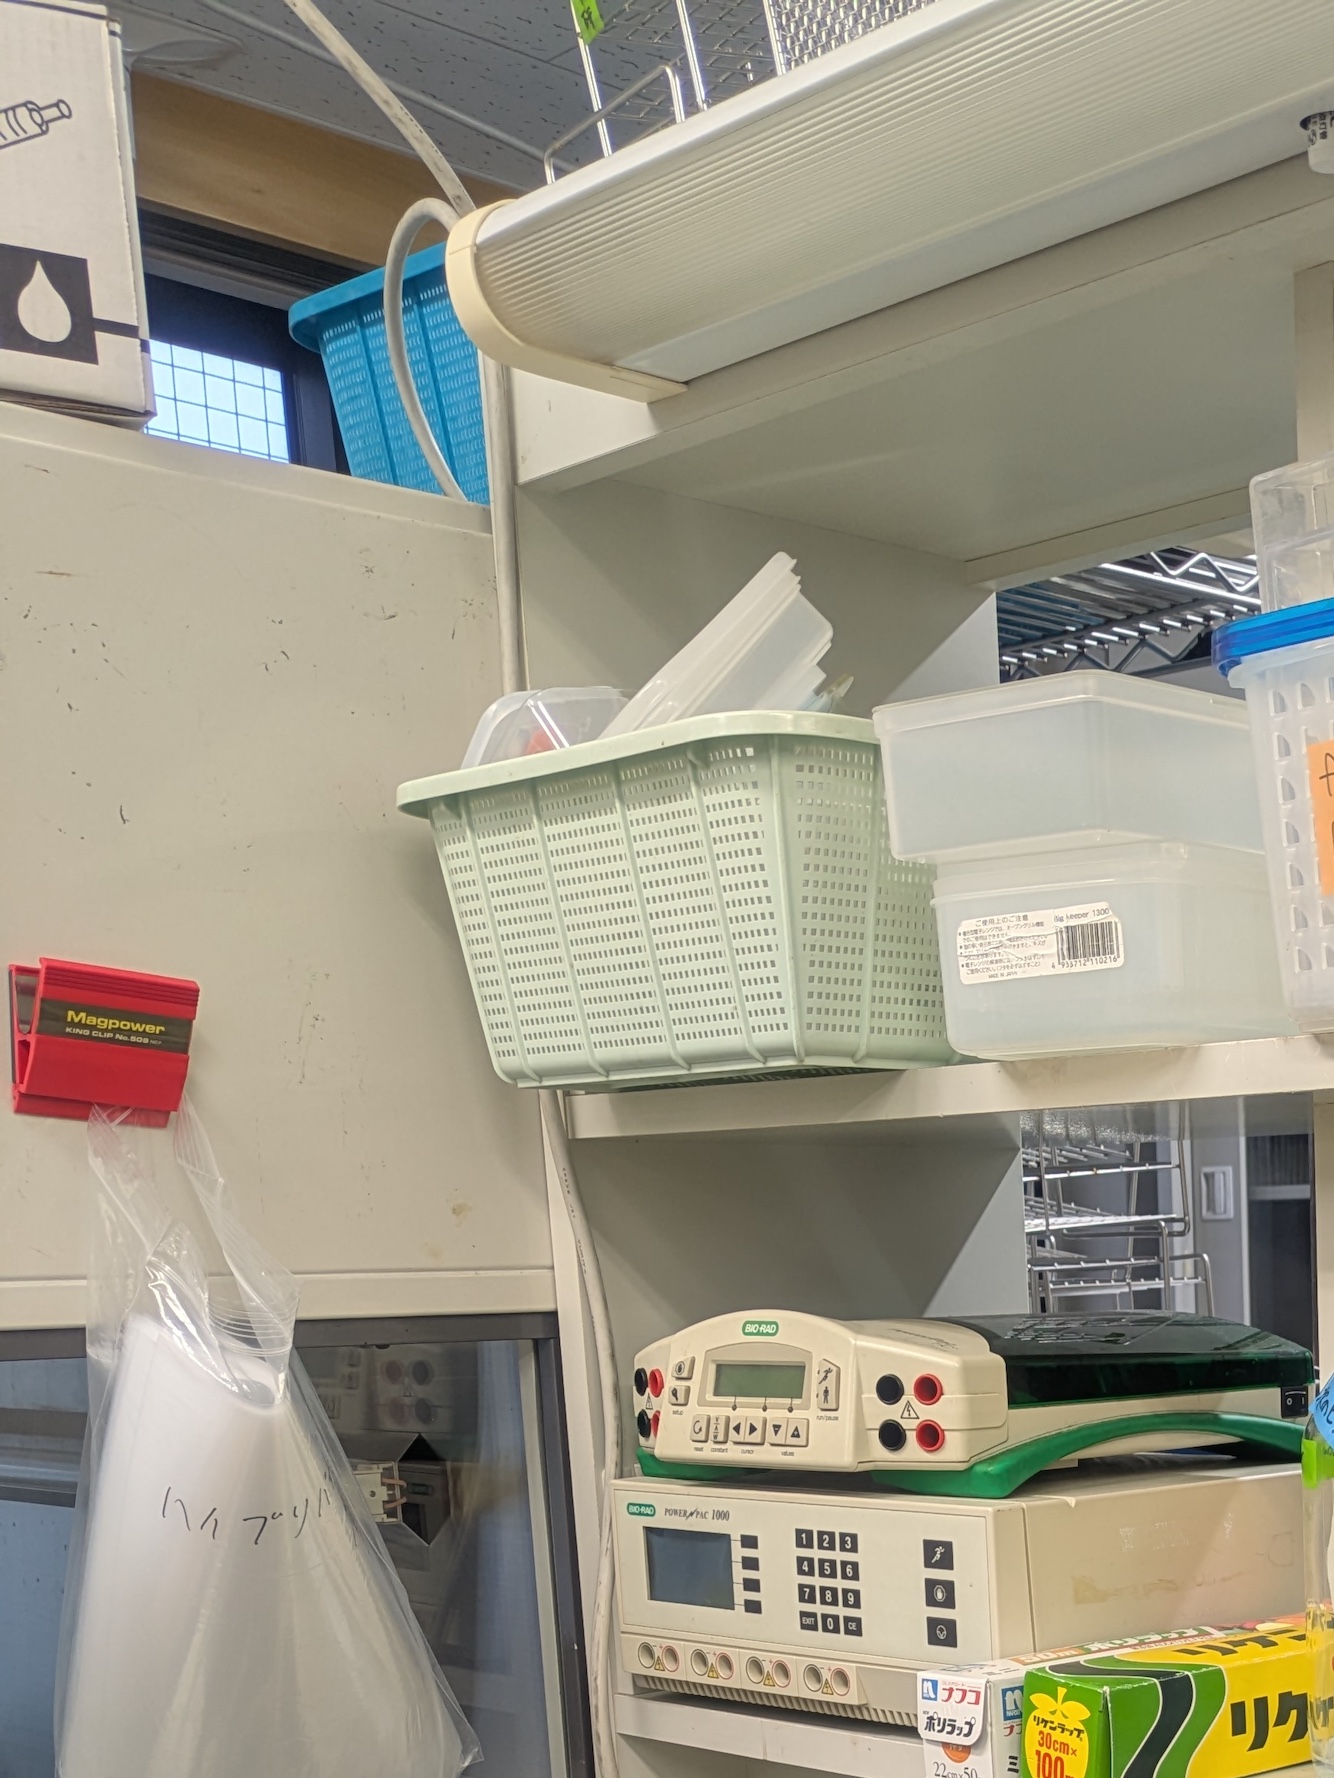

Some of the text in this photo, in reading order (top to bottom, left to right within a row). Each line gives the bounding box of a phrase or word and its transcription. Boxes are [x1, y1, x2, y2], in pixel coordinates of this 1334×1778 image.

[1092, 908, 1110, 917] 1300
[66, 1010, 165, 1035] Magpower
[66, 1027, 90, 1036] KING
[92, 1030, 114, 1039] CLIP
[115, 1034, 149, 1044] No.509
[711, 1509, 730, 1521] 1000
[801, 1533, 852, 1549] 1 2 3
[801, 1560, 853, 1577] 4 5 6
[803, 1588, 855, 1605] 7 8 9
[802, 1617, 857, 1631] EXIT 0 CE
[941, 1687, 981, 1705] ナフコ
[924, 1712, 977, 1738] ポリラップ
